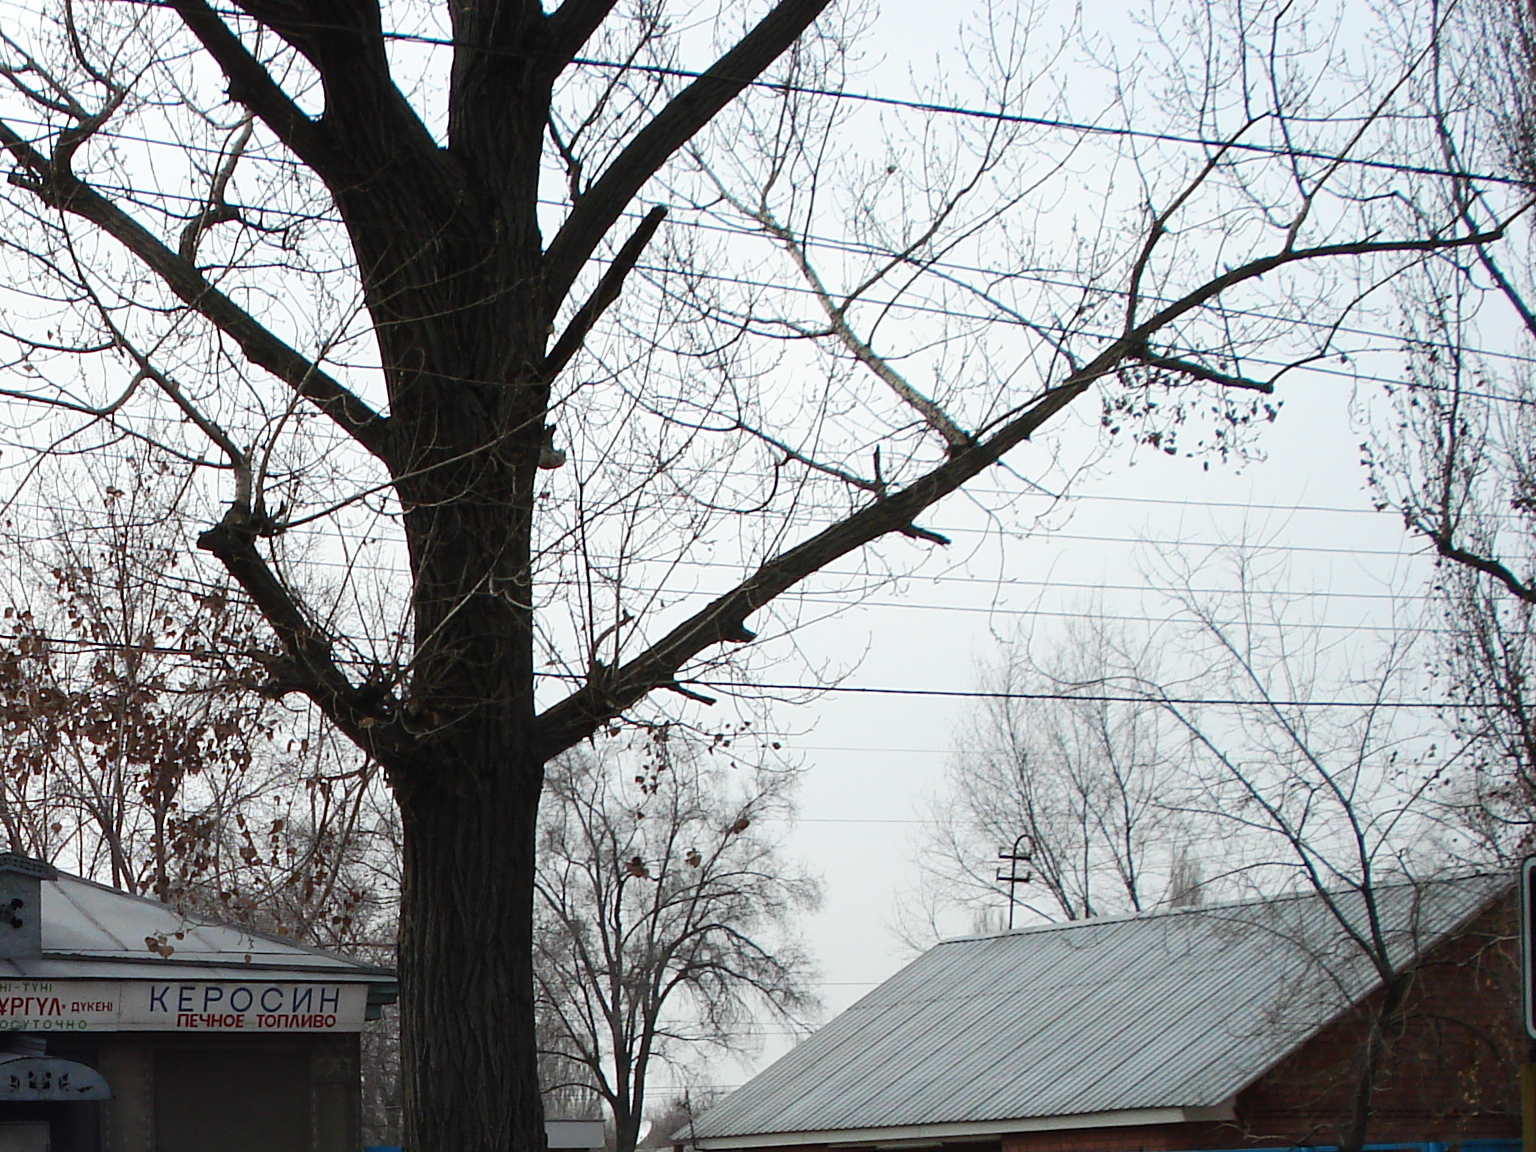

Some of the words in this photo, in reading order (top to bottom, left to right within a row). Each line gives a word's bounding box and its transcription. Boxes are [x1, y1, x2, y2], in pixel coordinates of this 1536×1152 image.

[71, 1001, 113, 1013] ДҮКЕНІ
[149, 986, 340, 1013] КЕРОСИН
[176, 1013, 245, 1028] ПЕЧНОЕ
[256, 1014, 337, 1028] ТОПЛИВО
